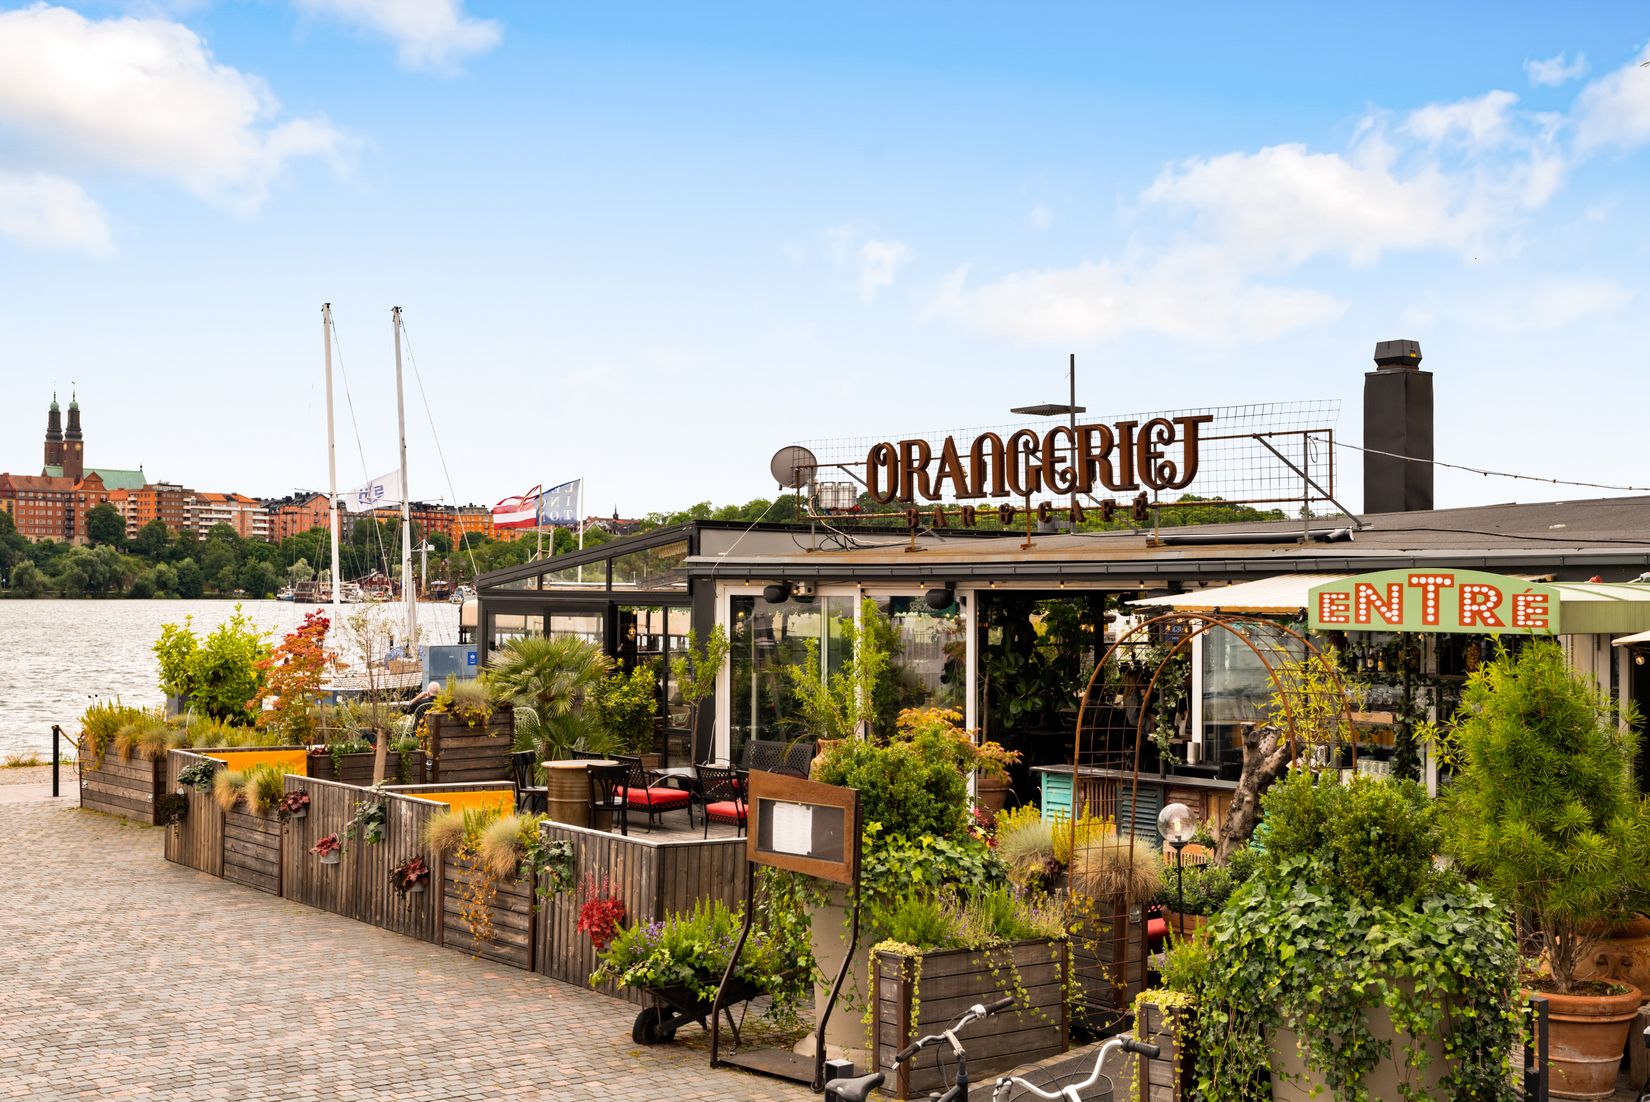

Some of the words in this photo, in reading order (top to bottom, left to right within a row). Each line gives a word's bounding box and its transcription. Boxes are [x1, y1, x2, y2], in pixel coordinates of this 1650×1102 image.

[866, 415, 1213, 504] ORANGERIET
[905, 505, 976, 528] BAR
[1038, 491, 1149, 523] CAFÉ
[1319, 574, 1549, 628] ENTRÉ
